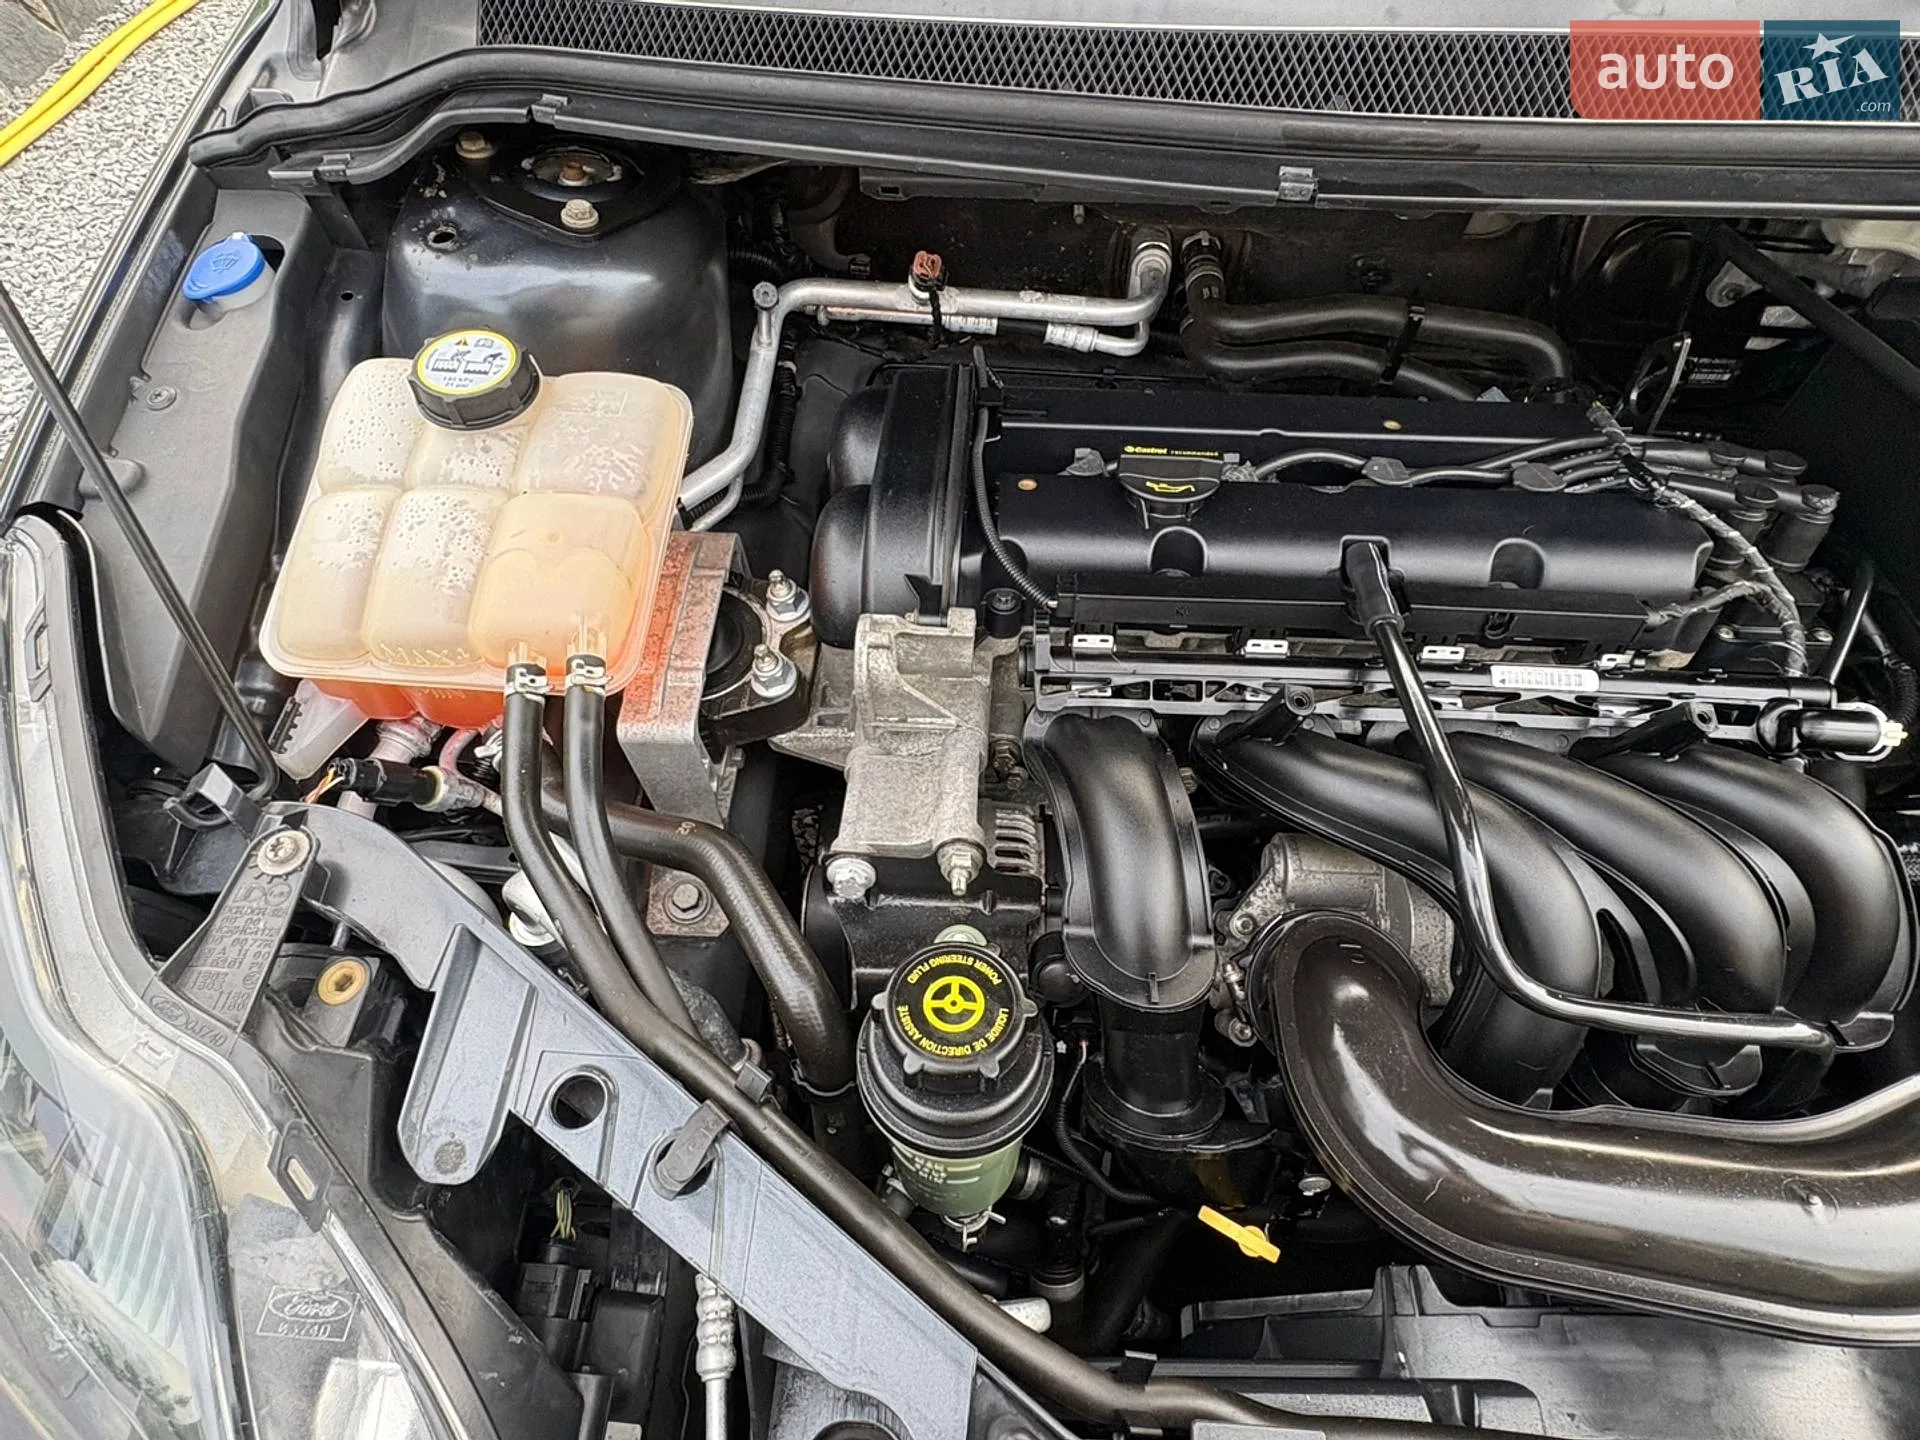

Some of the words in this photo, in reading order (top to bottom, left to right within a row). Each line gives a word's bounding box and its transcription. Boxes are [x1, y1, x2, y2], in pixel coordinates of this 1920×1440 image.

[1134, 446, 1168, 455] Castrol
[928, 954, 975, 968] STEERING
[906, 962, 931, 984] FLUID
[973, 959, 1002, 985] POWER
[985, 1007, 1010, 1043] LIQUIDE
[918, 1036, 972, 1056] DIRECTION
[972, 1038, 988, 1052] DE
[284, 1296, 340, 1317] Ford
